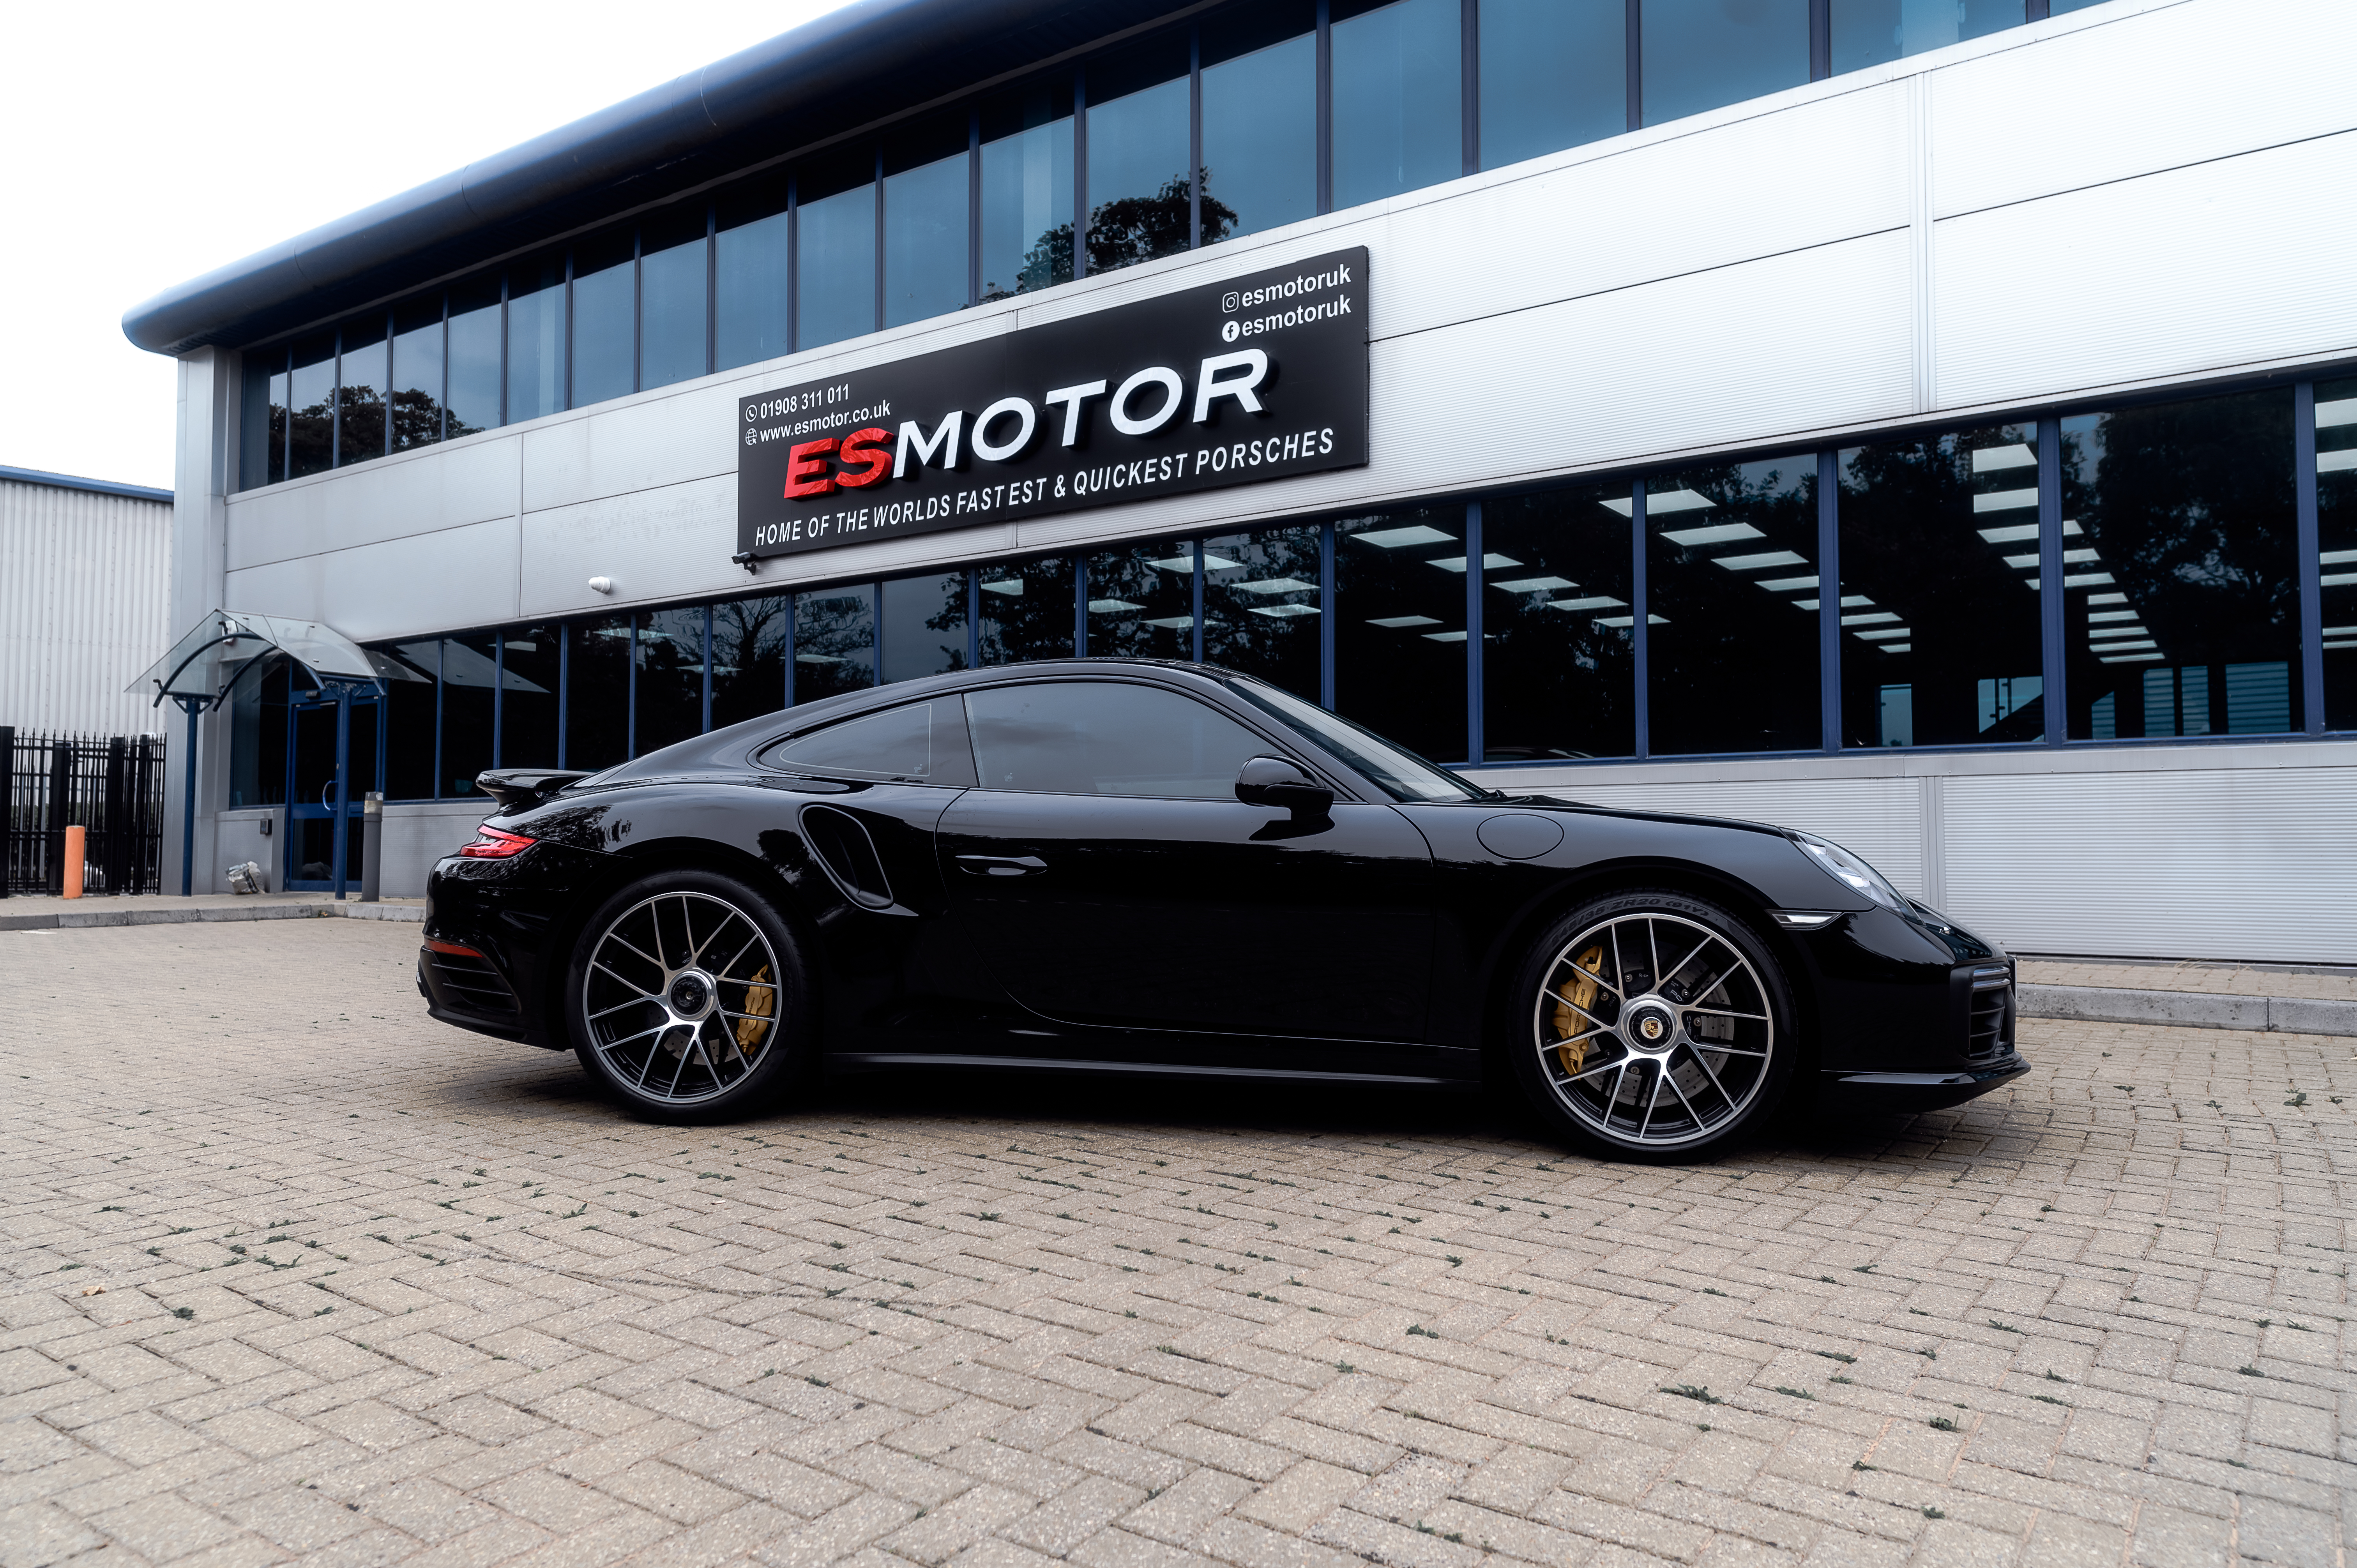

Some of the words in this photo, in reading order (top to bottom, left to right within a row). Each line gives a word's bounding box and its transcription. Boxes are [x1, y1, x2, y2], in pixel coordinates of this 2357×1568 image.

[1242, 263, 1351, 307] esmotoruk
[1242, 294, 1352, 336] esmotoruk
[760, 396, 797, 419] 01908
[801, 389, 822, 410] 311
[827, 383, 848, 404] 011
[760, 399, 891, 442] www.esmotor.co.uk
[784, 349, 1268, 498] ESMOTOR
[755, 519, 802, 546] HOME
[808, 515, 830, 538] OF
[836, 509, 869, 533] THE
[874, 495, 950, 528] WORLDS
[956, 477, 1047, 514] FASTEST
[1054, 475, 1065, 498] &
[1074, 453, 1188, 496] QUICKEST
[1196, 428, 1333, 475] PORSCHES
[1551, 907, 1605, 947] 245/35
[1608, 898, 1661, 910] ZR20
[1665, 901, 1709, 917] (91Y)
[1574, 988, 1586, 1034] PORCHE
